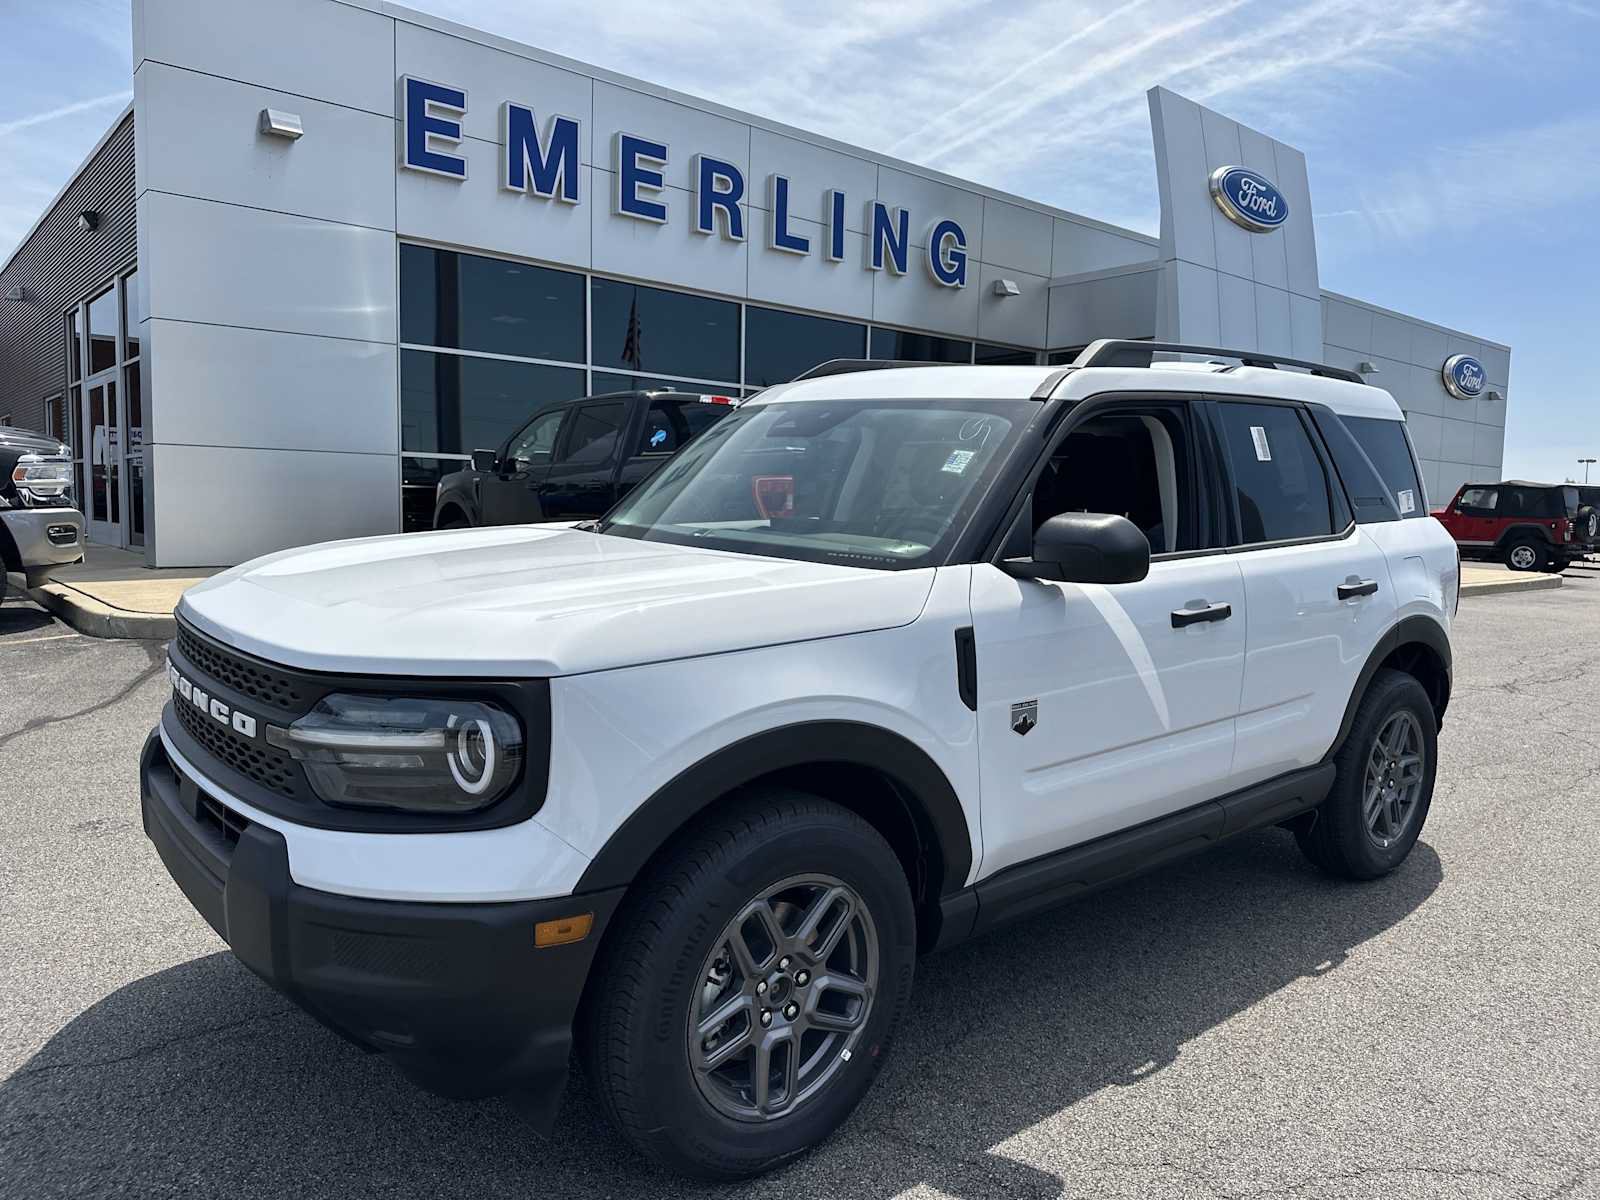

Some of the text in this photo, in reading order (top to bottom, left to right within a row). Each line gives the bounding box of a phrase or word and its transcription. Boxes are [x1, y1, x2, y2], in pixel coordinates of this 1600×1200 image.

[398, 74, 968, 289] EMERLING
[1238, 178, 1277, 217] Ford
[1460, 364, 1483, 389] Ford
